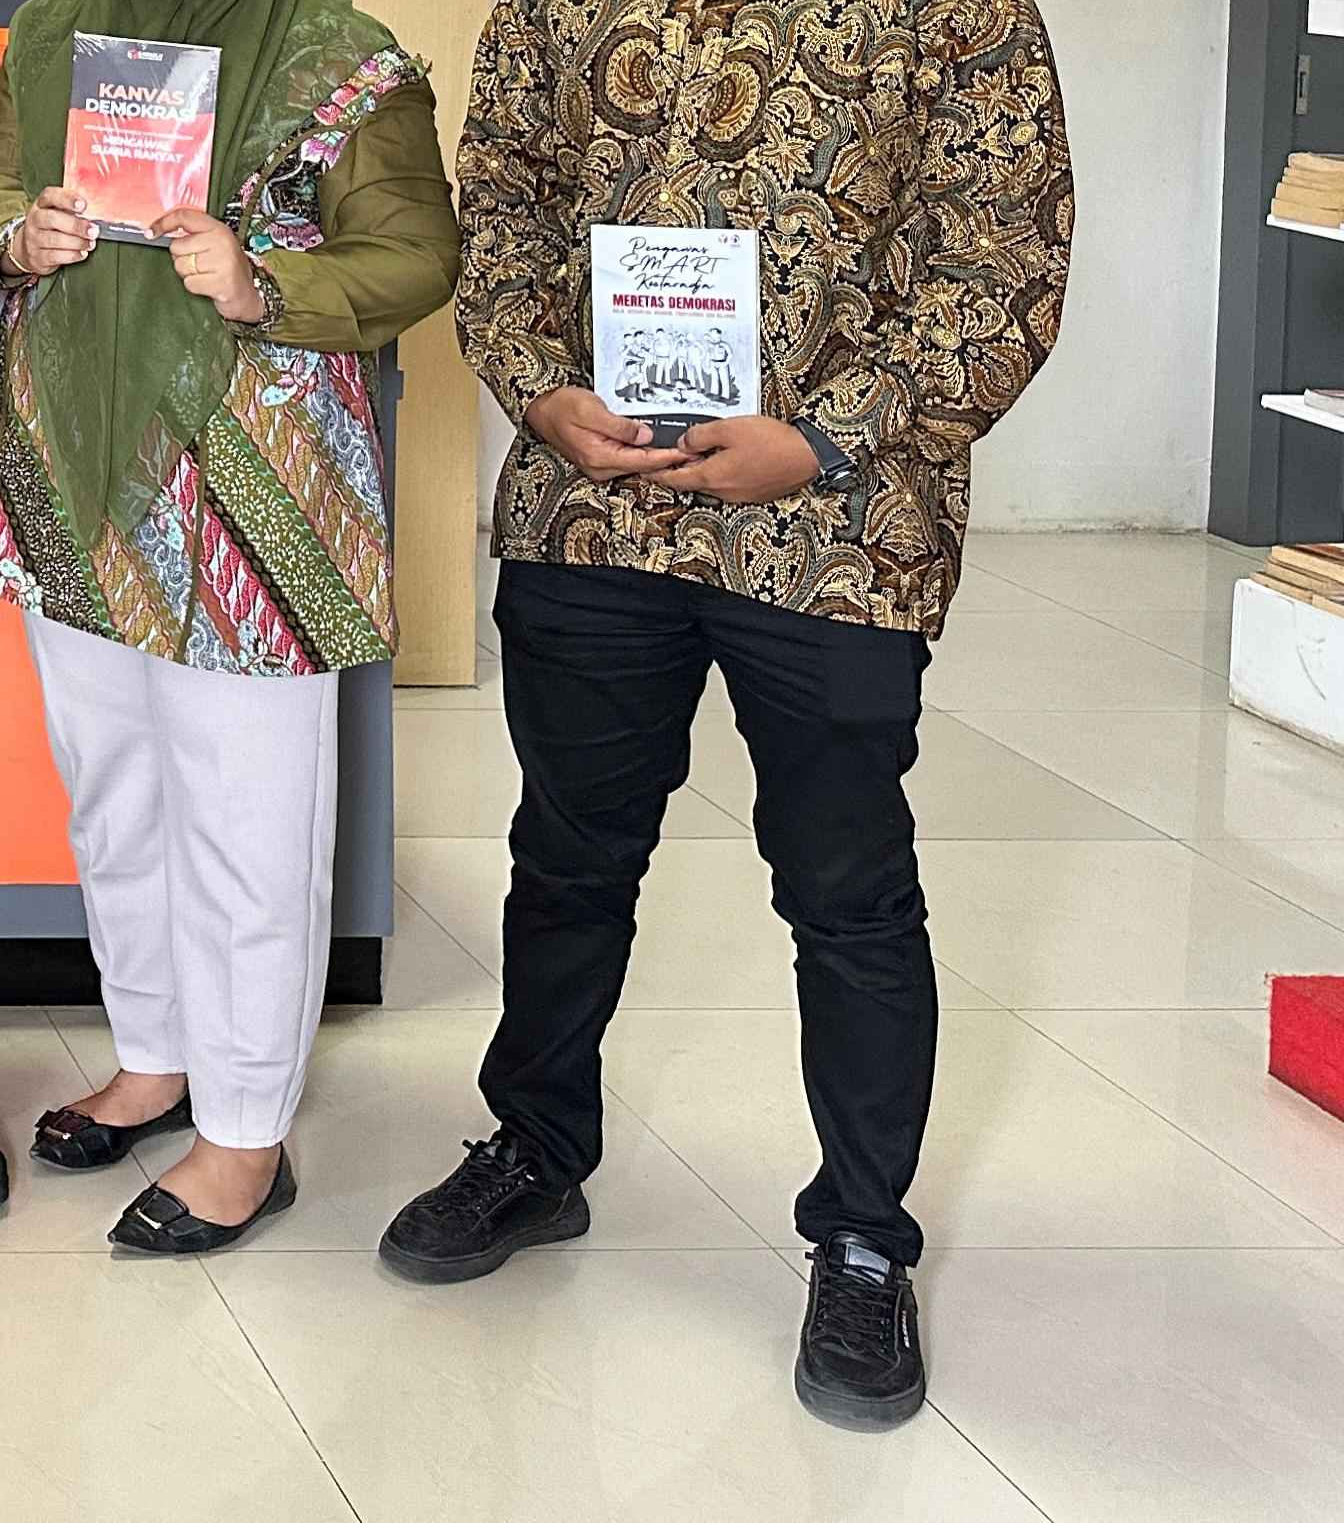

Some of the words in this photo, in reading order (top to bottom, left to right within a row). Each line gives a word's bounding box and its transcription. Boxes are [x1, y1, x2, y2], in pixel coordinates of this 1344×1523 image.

[98, 81, 185, 106] KANVAS
[612, 293, 665, 309] MERETAS
[668, 295, 736, 312] DEMOKRASI
